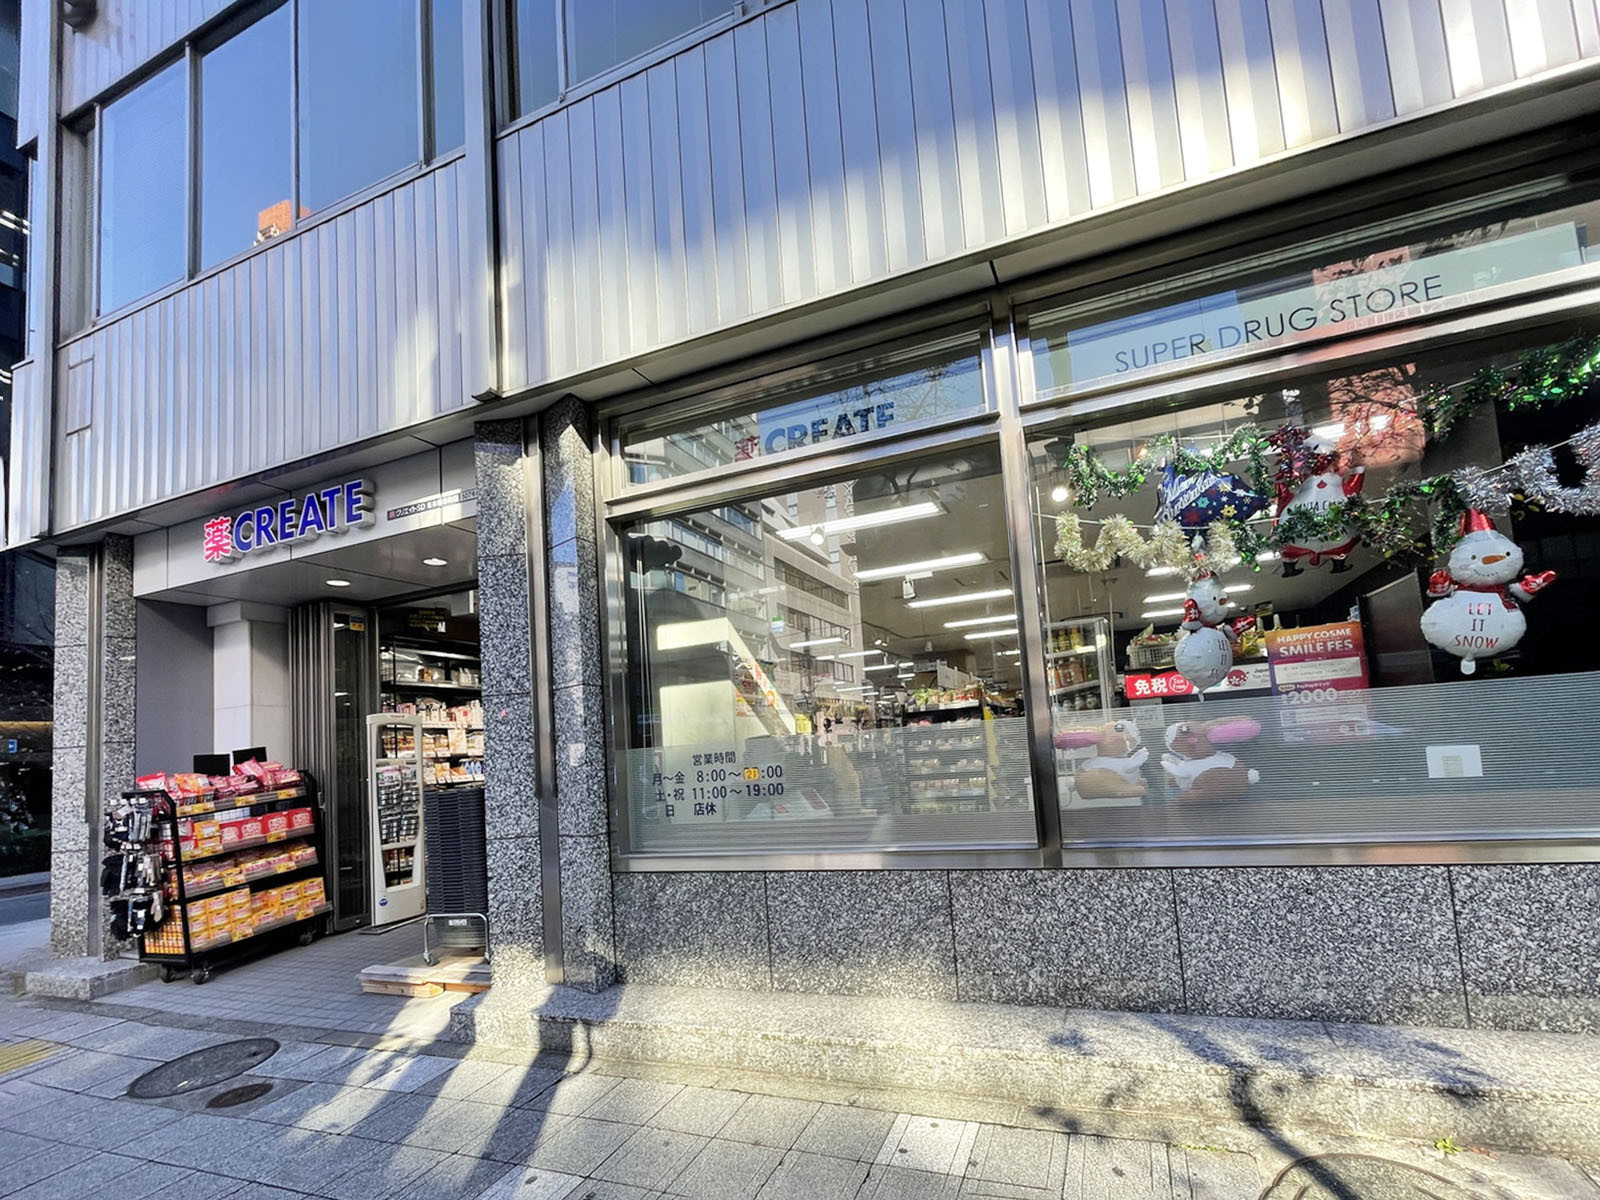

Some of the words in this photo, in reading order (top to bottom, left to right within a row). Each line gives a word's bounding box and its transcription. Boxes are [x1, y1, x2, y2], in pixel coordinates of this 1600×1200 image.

[1115, 333, 1206, 373] SUPER
[1219, 307, 1317, 349] DRUG
[1331, 275, 1443, 322] STORE
[233, 479, 364, 553] CREATE
[1469, 602, 1492, 616] LET
[1471, 619, 1485, 632] IT
[1277, 632, 1312, 643] HAPPY
[1314, 628, 1352, 639] COSME
[1454, 634, 1499, 649] SNOW
[1280, 644, 1324, 657] SMILE
[1327, 639, 1353, 652] FES
[1134, 678, 1168, 695] 免税
[692, 751, 736, 766] 営業時間
[665, 805, 675, 817] 日
[694, 802, 716, 816] 店休
